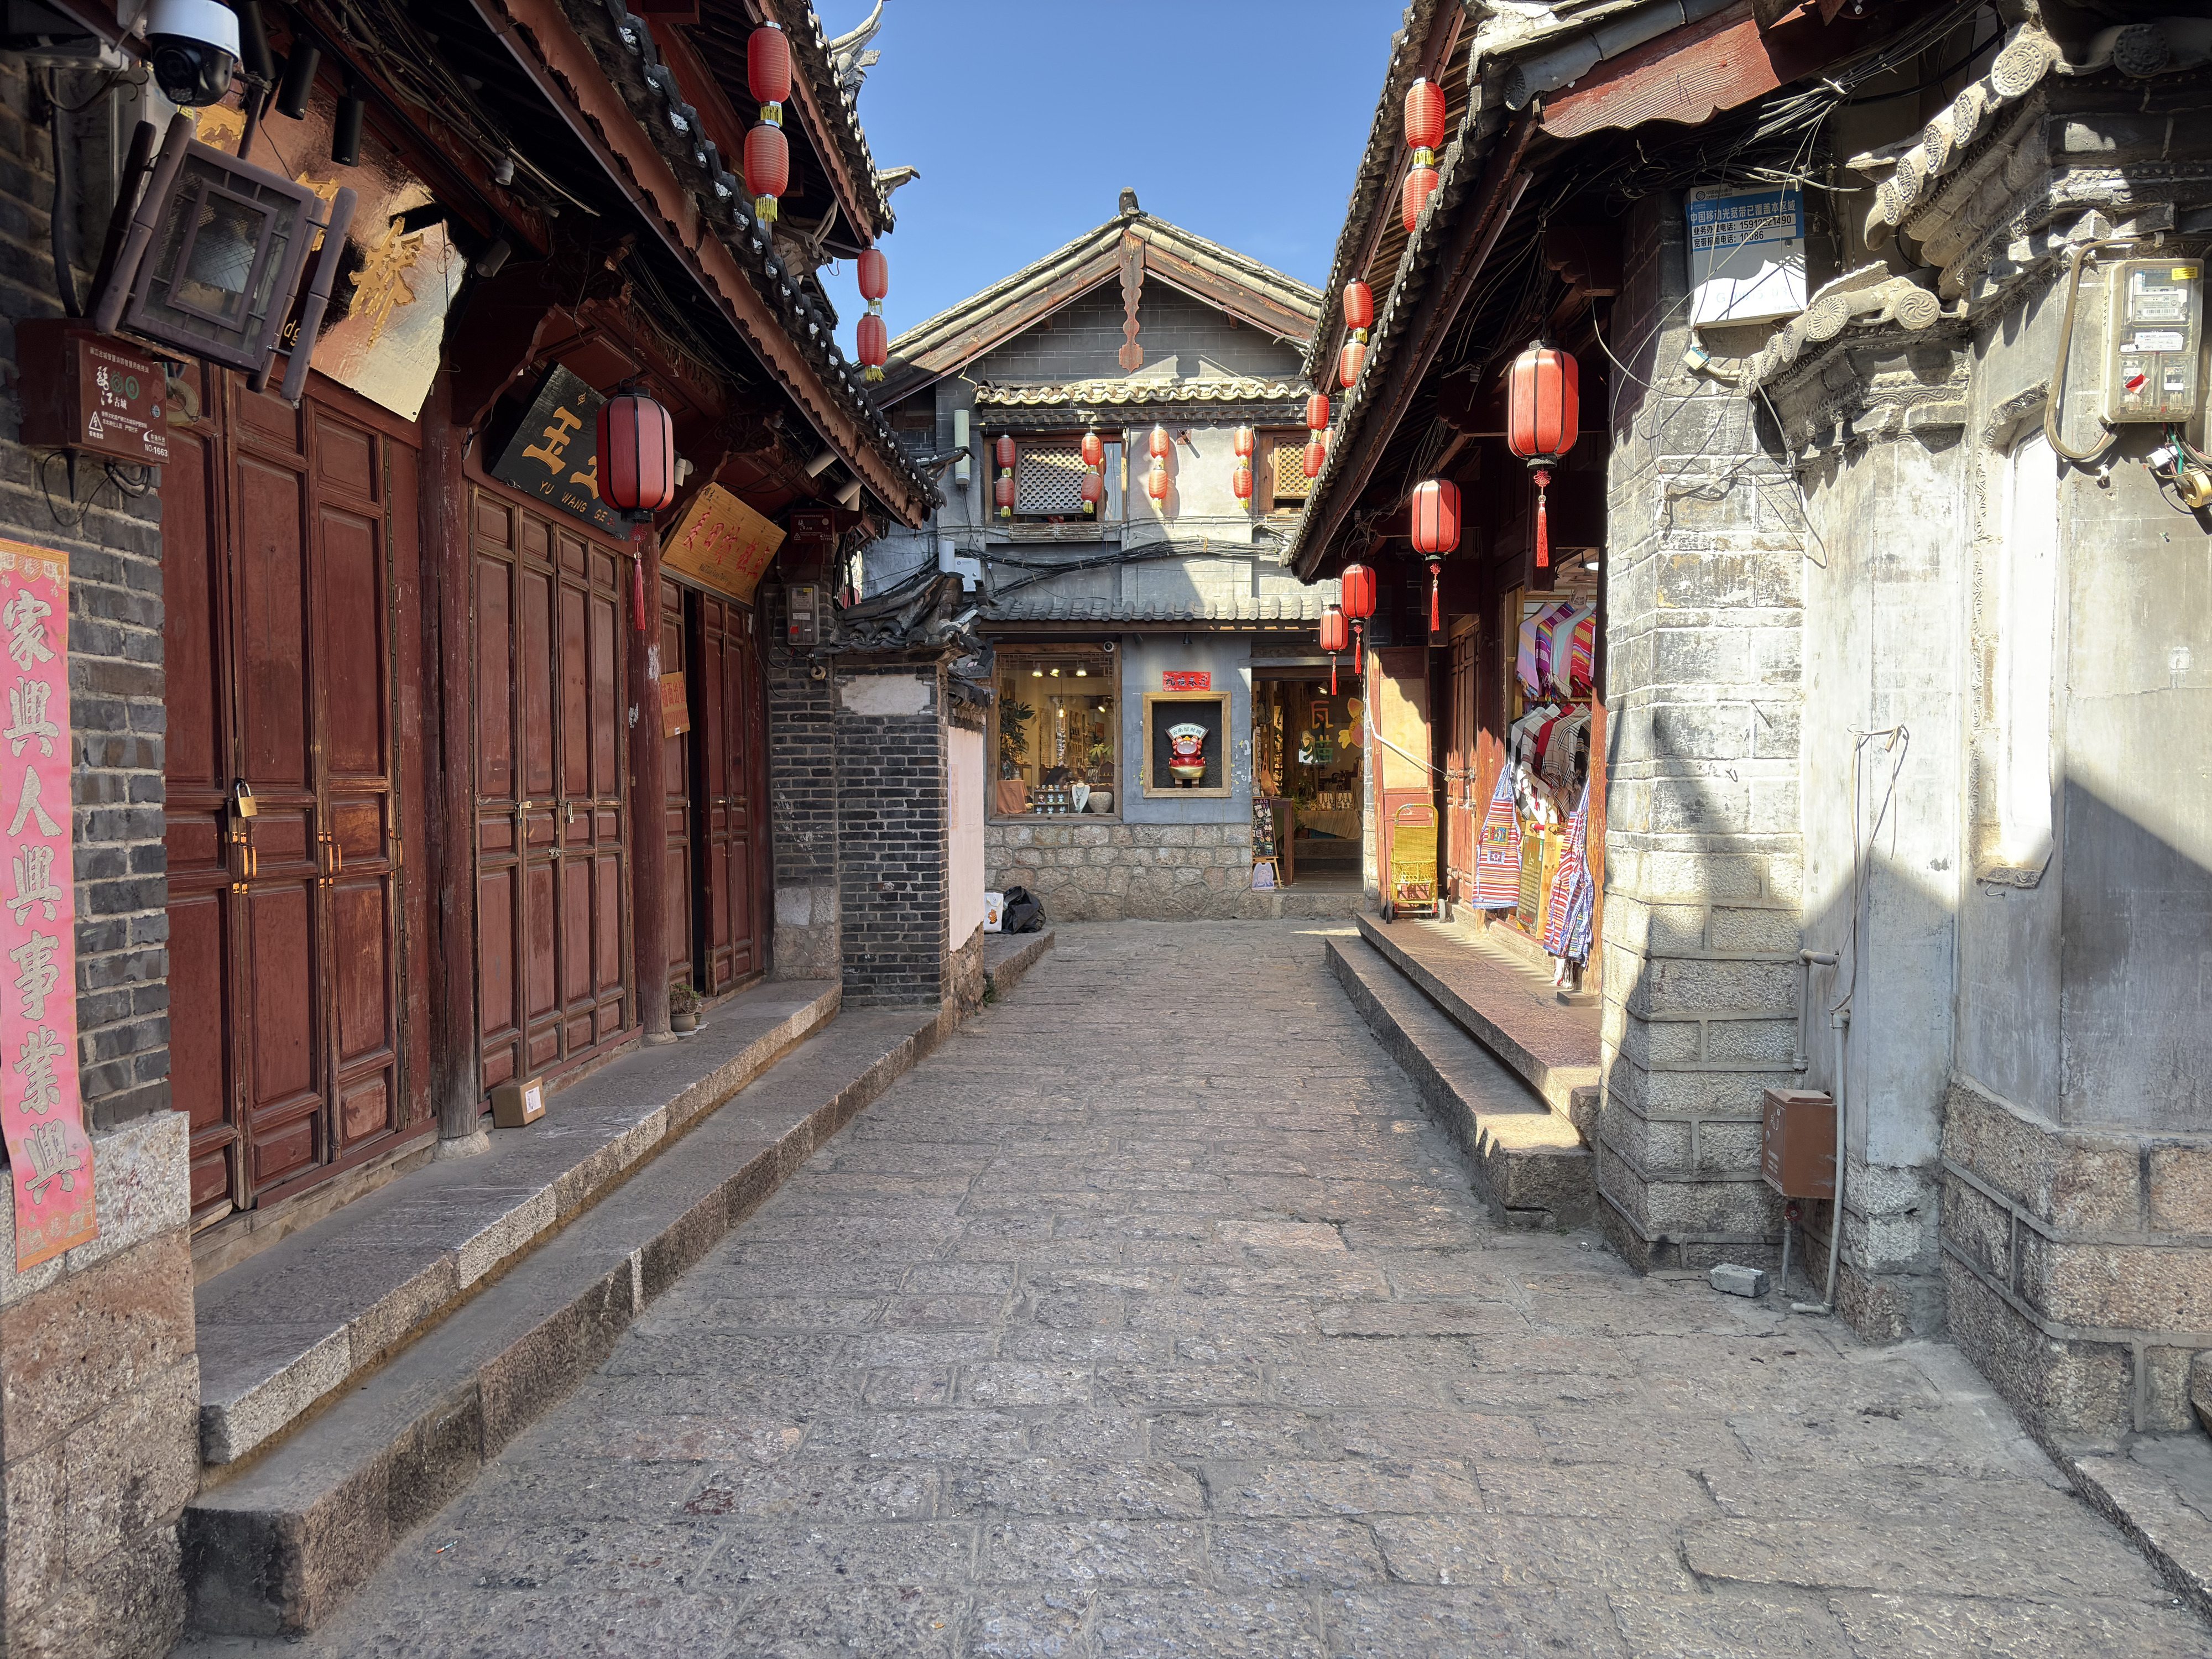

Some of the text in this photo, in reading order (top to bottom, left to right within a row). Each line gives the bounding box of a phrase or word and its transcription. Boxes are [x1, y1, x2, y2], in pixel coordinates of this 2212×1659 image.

[1691, 200, 1796, 224] 中国移动光宽带已覆盖本区域
[1740, 230, 1764, 242] 10086
[539, 480, 608, 522] YU WANG GE
